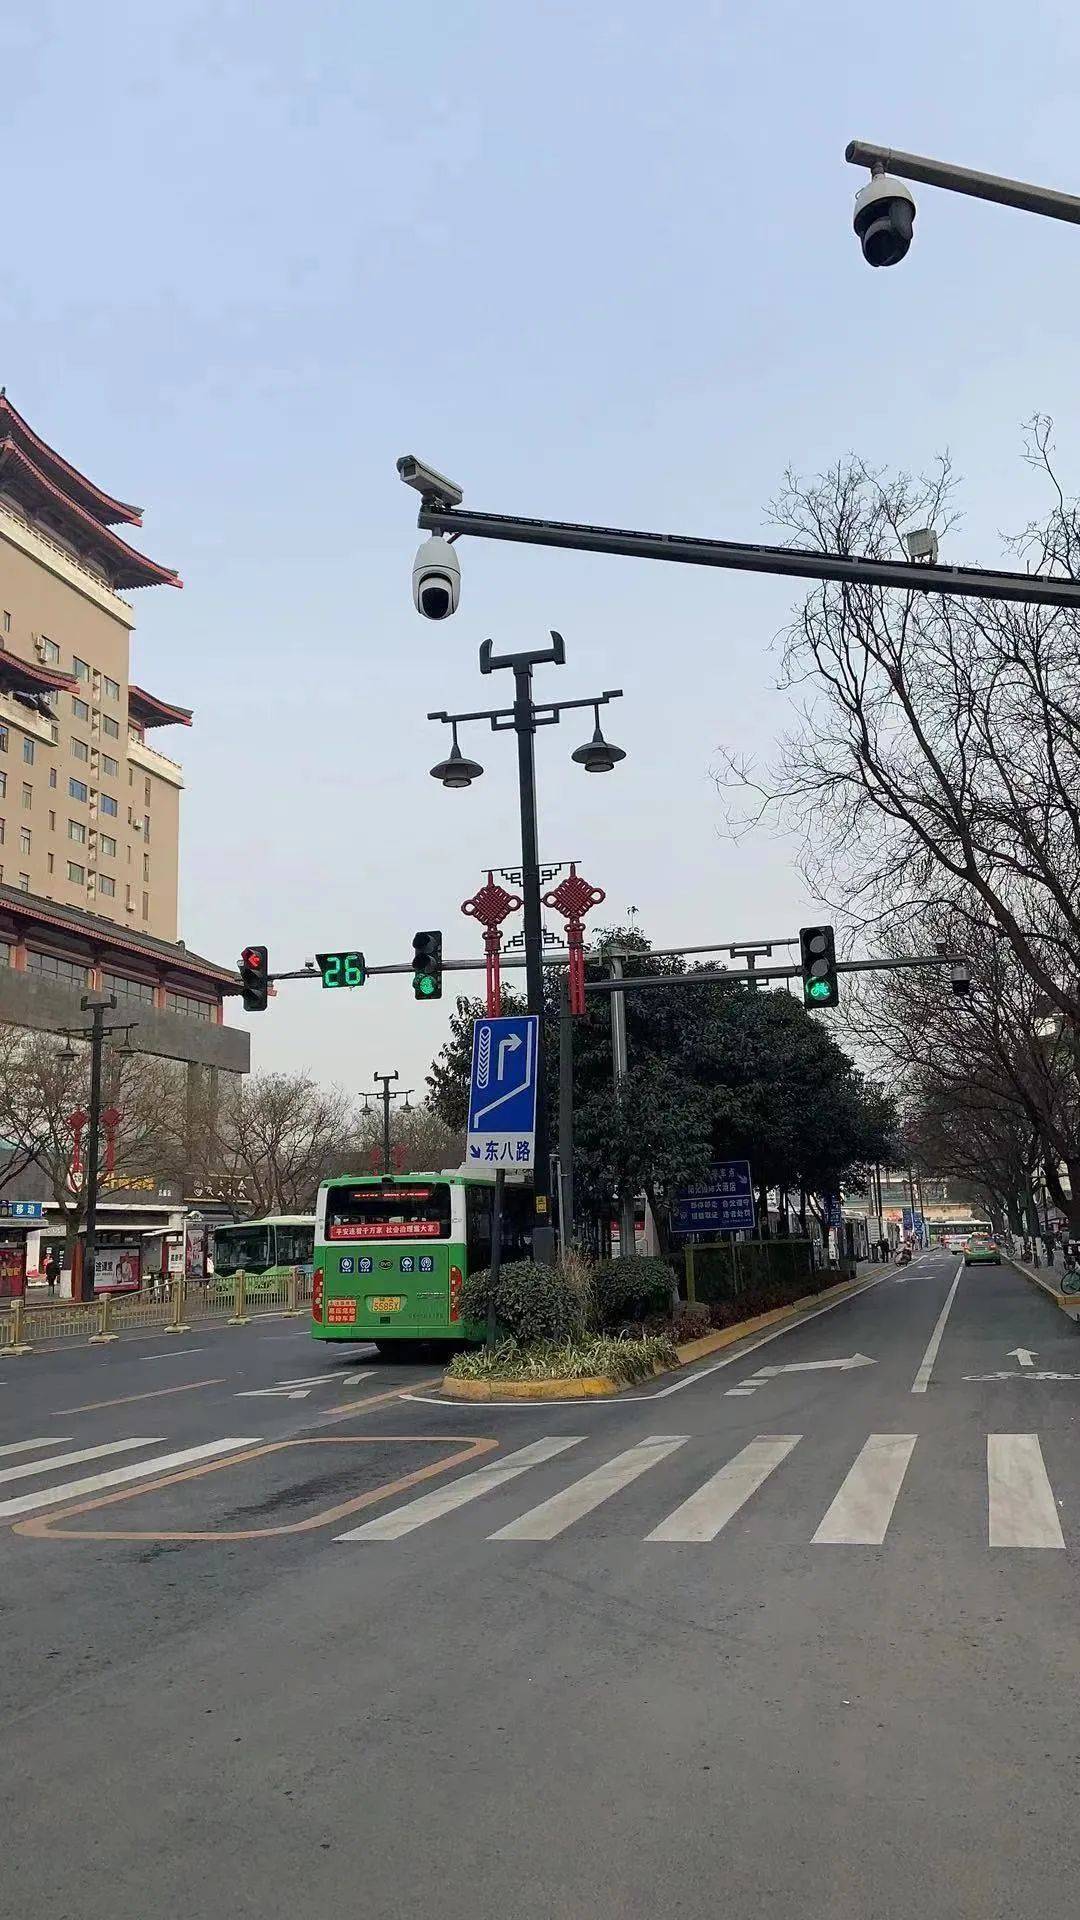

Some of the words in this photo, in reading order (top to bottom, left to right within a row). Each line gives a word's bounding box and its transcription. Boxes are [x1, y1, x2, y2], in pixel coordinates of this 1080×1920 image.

[325, 956, 361, 986] 26
[485, 1140, 530, 1161] 东八路
